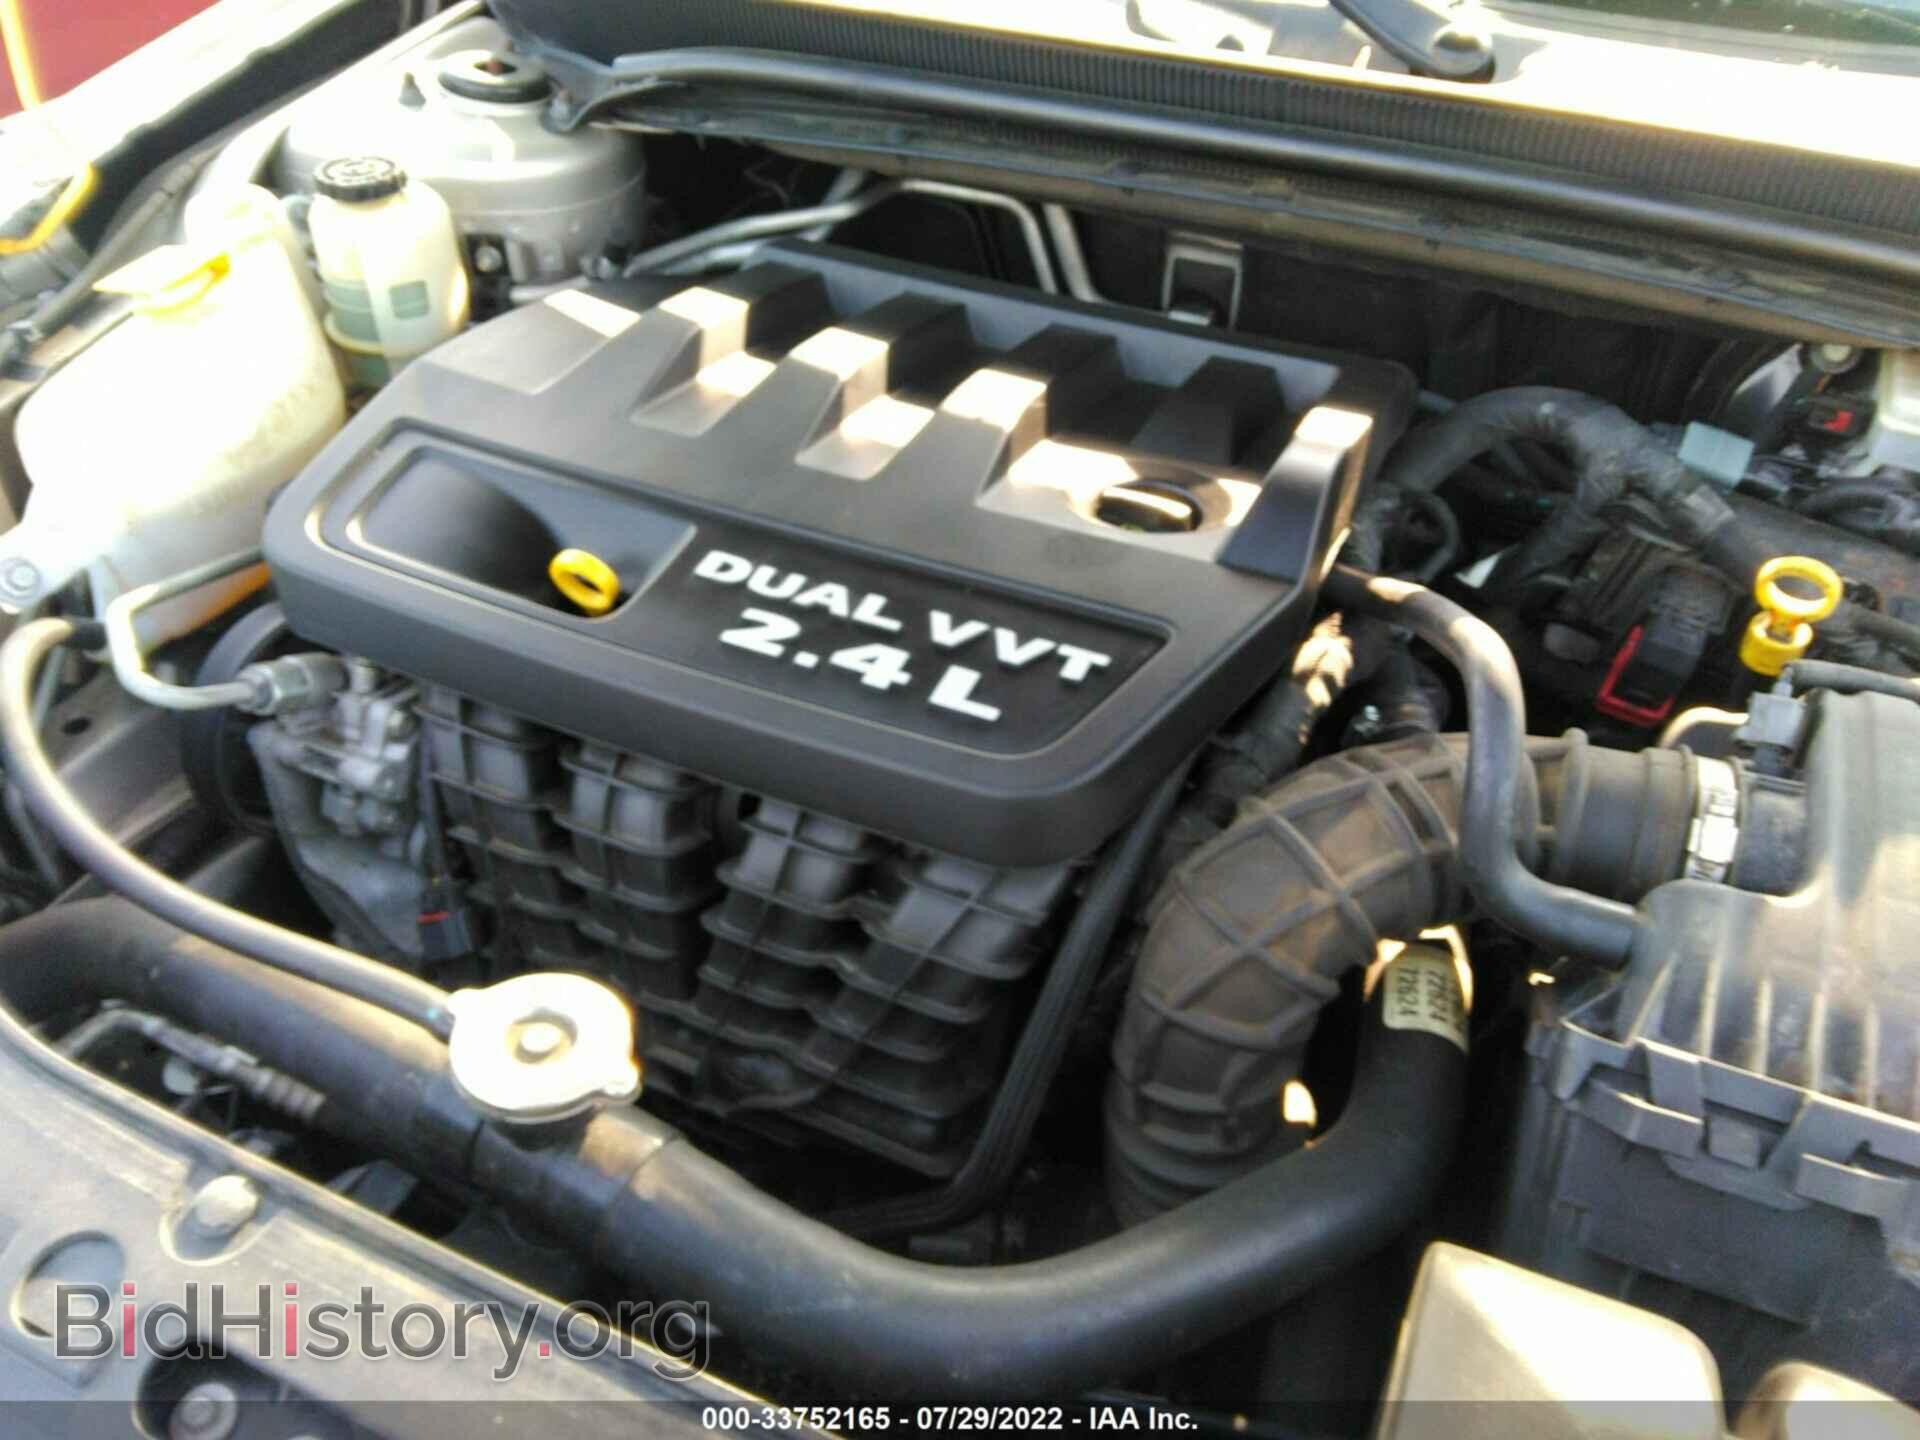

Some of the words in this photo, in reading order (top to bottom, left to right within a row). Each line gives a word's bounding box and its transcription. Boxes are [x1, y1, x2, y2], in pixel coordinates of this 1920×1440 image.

[693, 550, 903, 632] DUAL
[929, 609, 1112, 682] VVT
[719, 607, 912, 690] 2.4
[927, 664, 1002, 722] L
